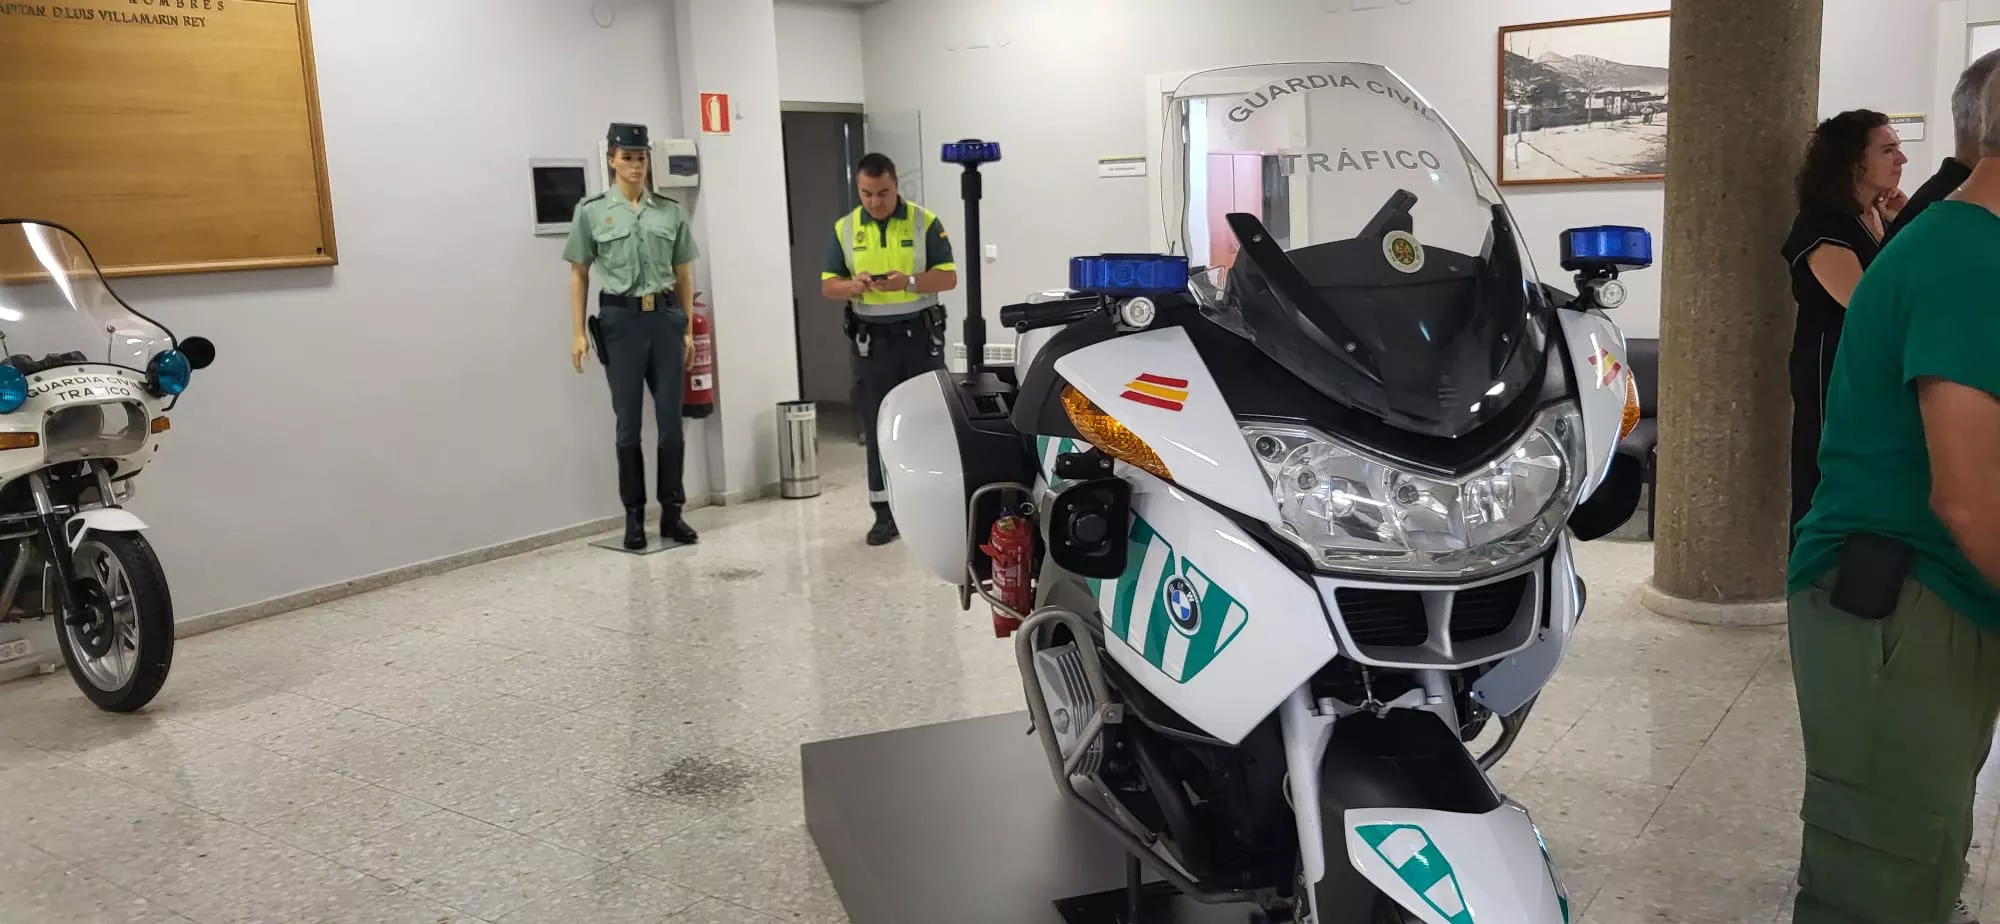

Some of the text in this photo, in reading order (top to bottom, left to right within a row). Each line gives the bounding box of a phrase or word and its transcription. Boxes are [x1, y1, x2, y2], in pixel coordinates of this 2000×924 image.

[98, 9, 178, 26] VILLAMARIN
[182, 15, 206, 28] REY
[1228, 75, 1435, 122] GUARDIA CIVIL
[1281, 147, 1440, 174] TRÁFICO
[27, 376, 104, 398] GUARDIA
[55, 386, 130, 401] TRAICO
[1169, 581, 1195, 602] BMW
